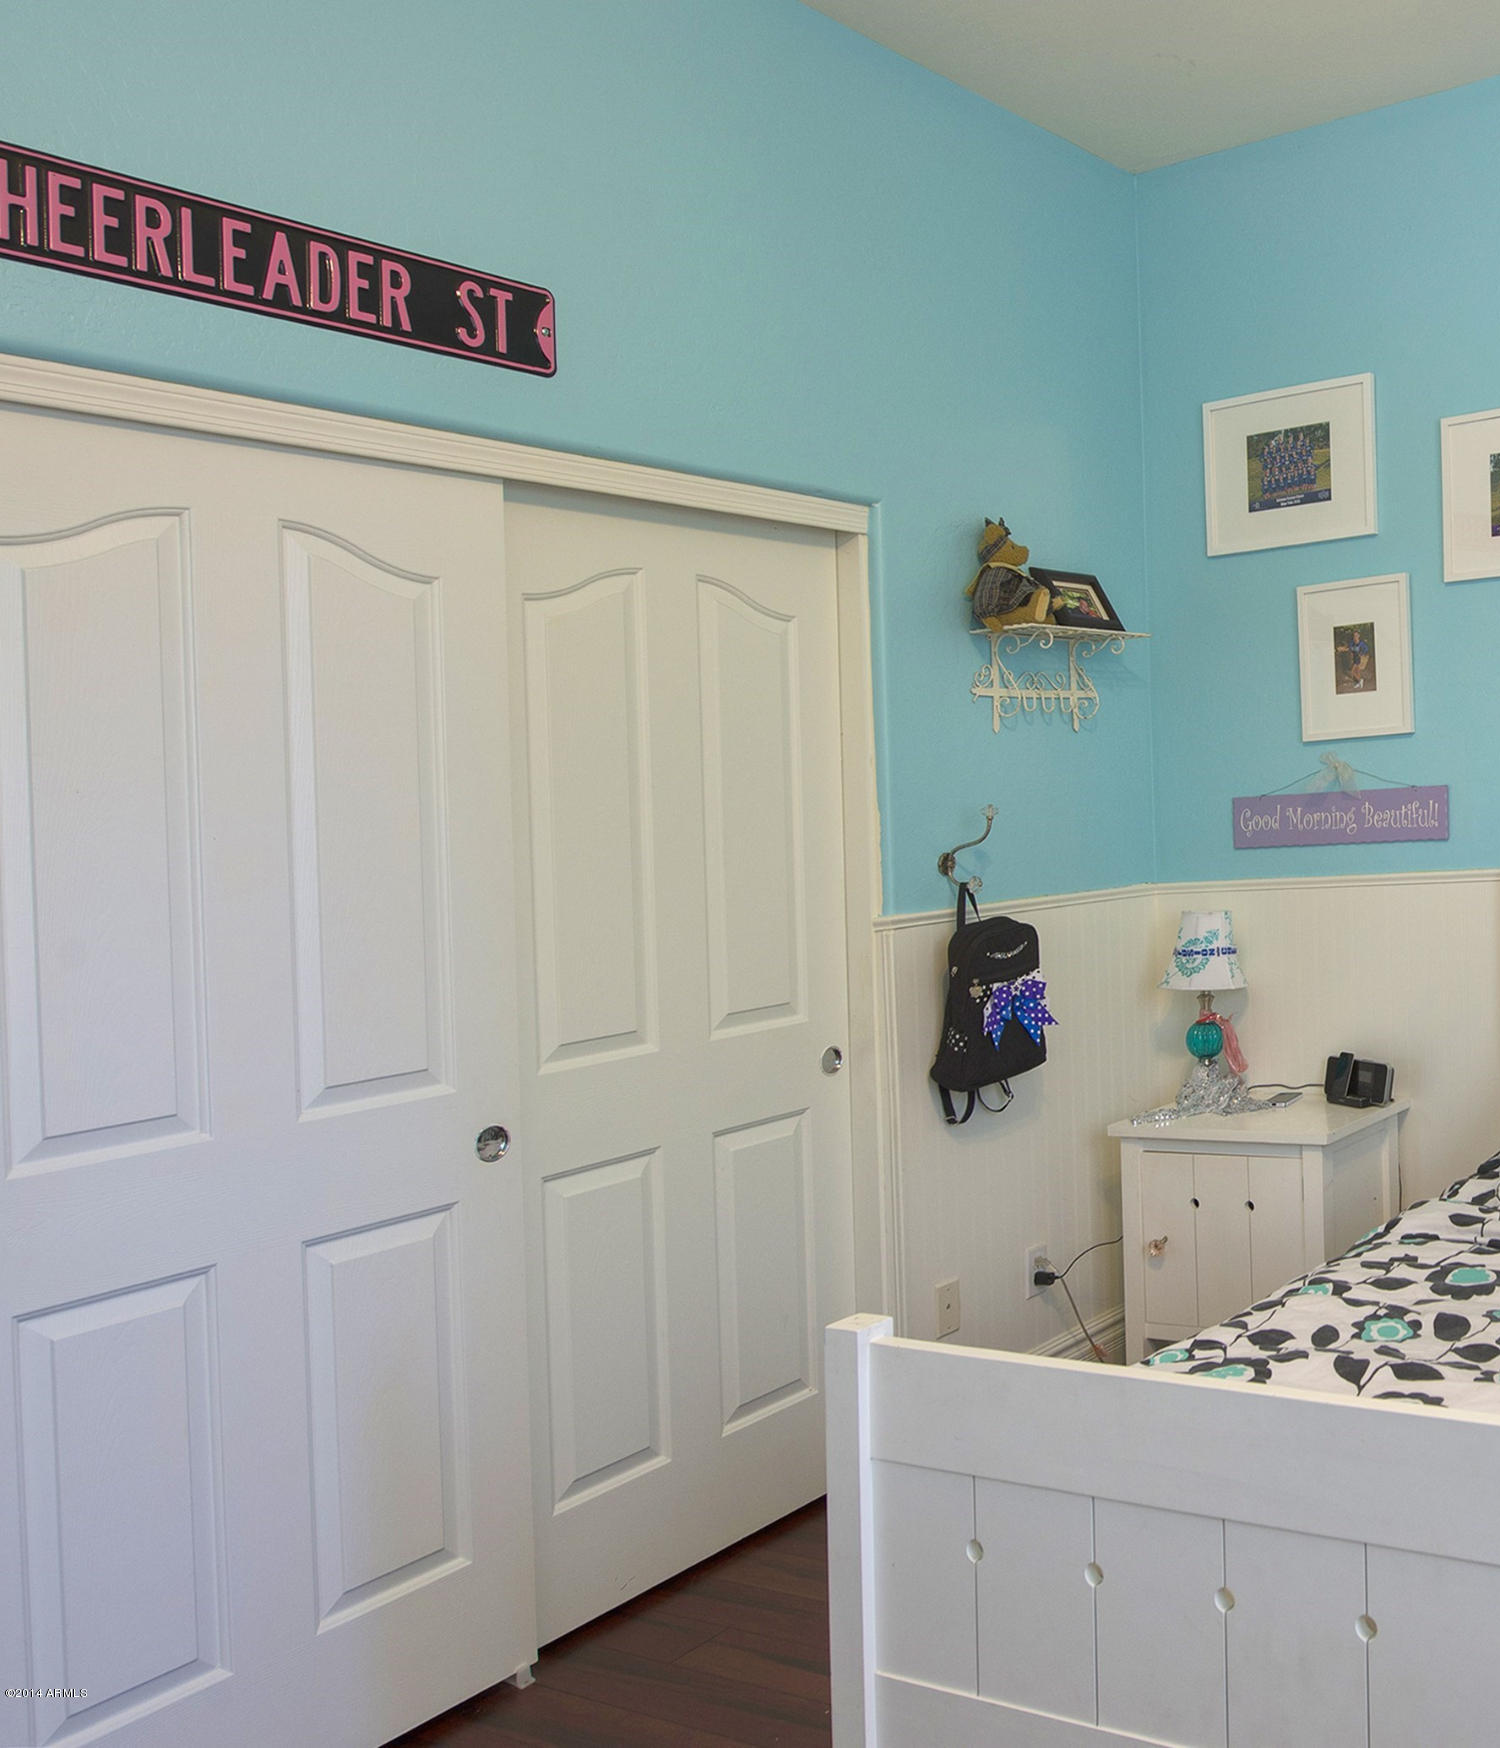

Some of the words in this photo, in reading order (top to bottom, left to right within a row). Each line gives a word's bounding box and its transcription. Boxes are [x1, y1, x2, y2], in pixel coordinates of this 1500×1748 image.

[455, 281, 513, 354] ST
[1240, 805, 1281, 836] Good
[1286, 806, 1357, 835] Morning
[1361, 800, 1439, 829] Beautiful!
